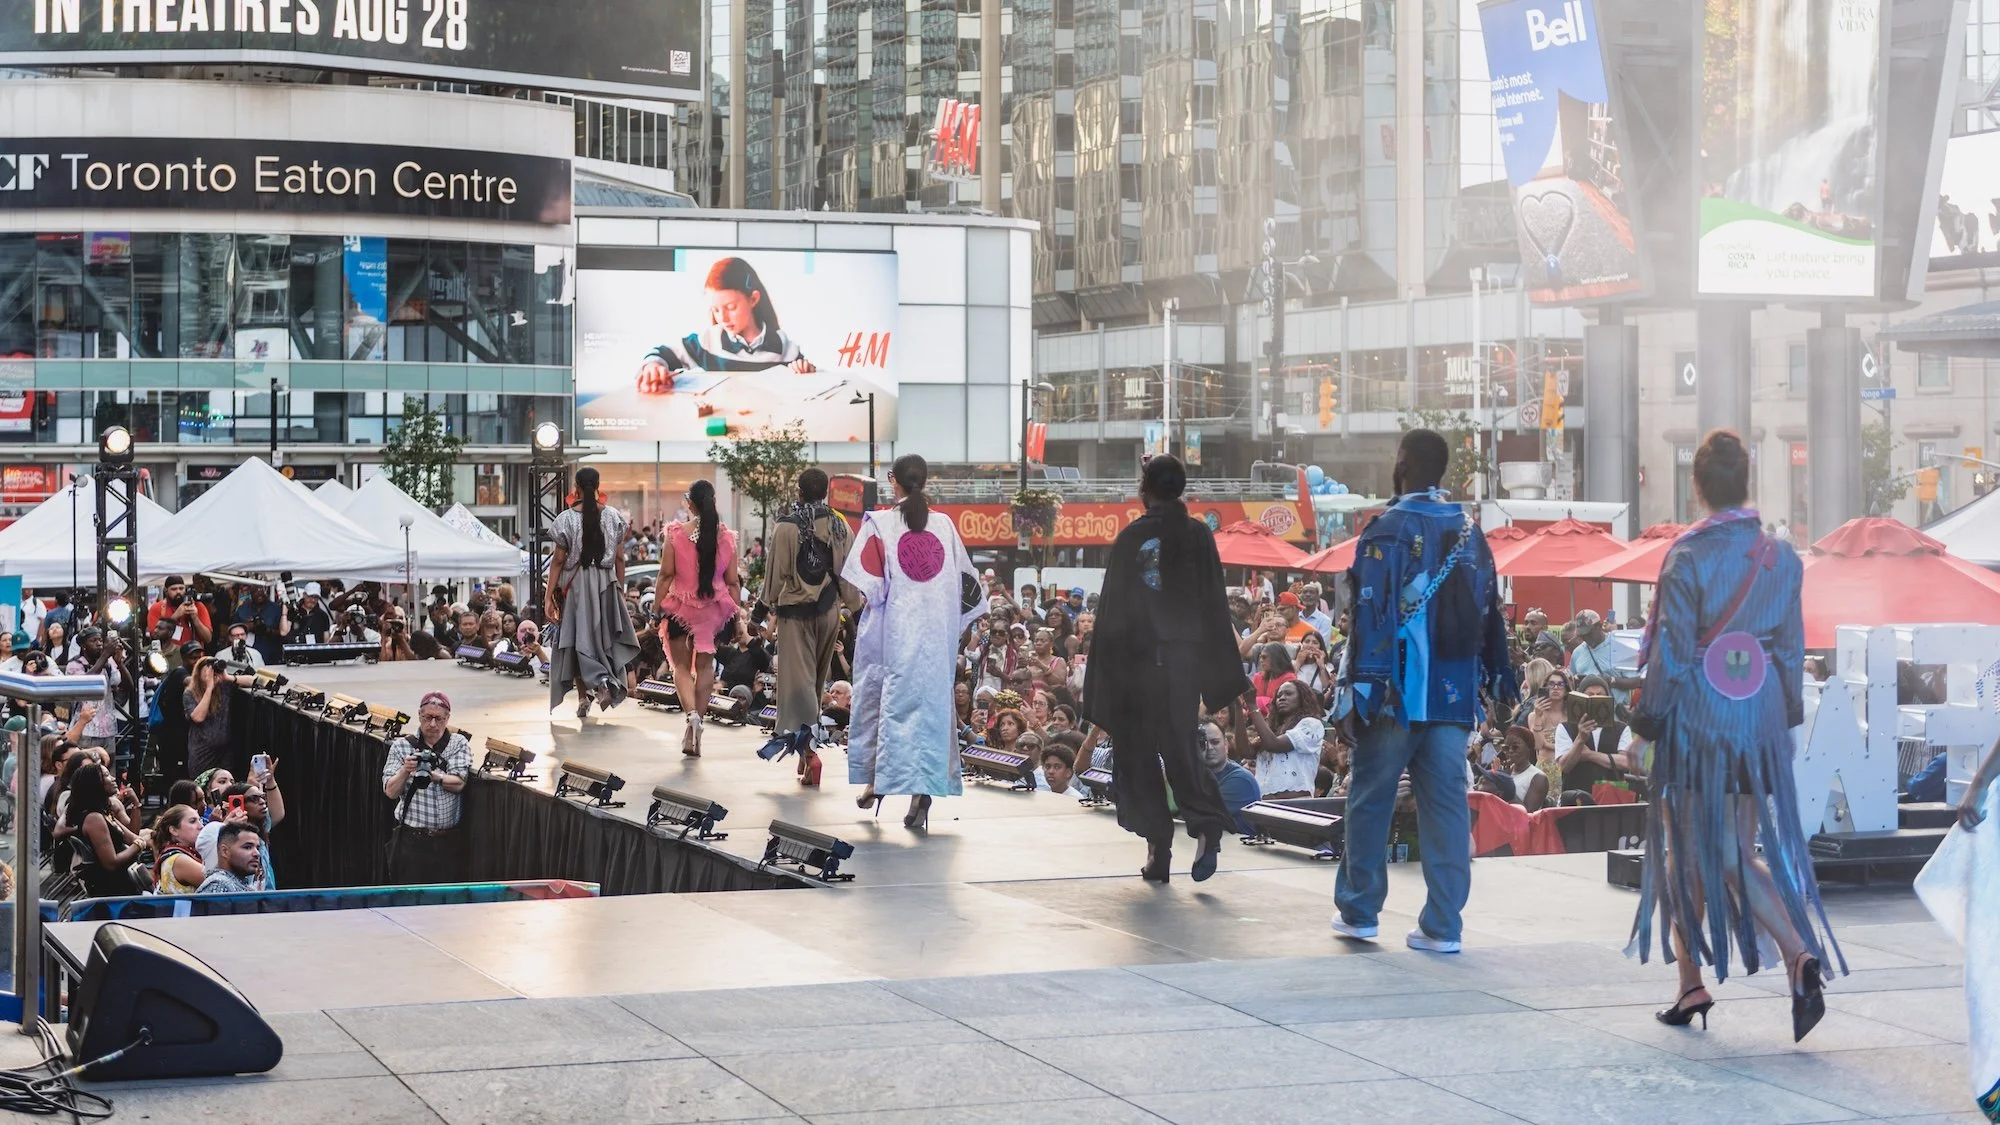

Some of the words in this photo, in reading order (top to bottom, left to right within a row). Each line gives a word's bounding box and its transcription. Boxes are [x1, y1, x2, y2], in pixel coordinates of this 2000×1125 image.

[34, 0, 80, 34] IN
[101, 0, 320, 36] THEATRES
[333, 0, 408, 44] AUG
[421, 0, 468, 50] 28
[1526, 0, 1587, 51] Bell
[1509, 71, 1533, 88] most
[934, 98, 981, 175] H&M
[61, 153, 237, 192] Toronto
[254, 156, 376, 195] Eaton
[392, 161, 518, 204] Centre
[1727, 252, 1756, 261] COSTA
[1767, 252, 1787, 263] Let
[1790, 252, 1830, 264] nature
[1833, 252, 1866, 266] bring
[1727, 262, 1749, 270] RICA
[1767, 270, 1790, 281] you
[838, 332, 891, 368] H&M
[584, 418, 605, 426] BACK
[606, 418, 617, 426] TO
[618, 418, 648, 426] SCHOOL
